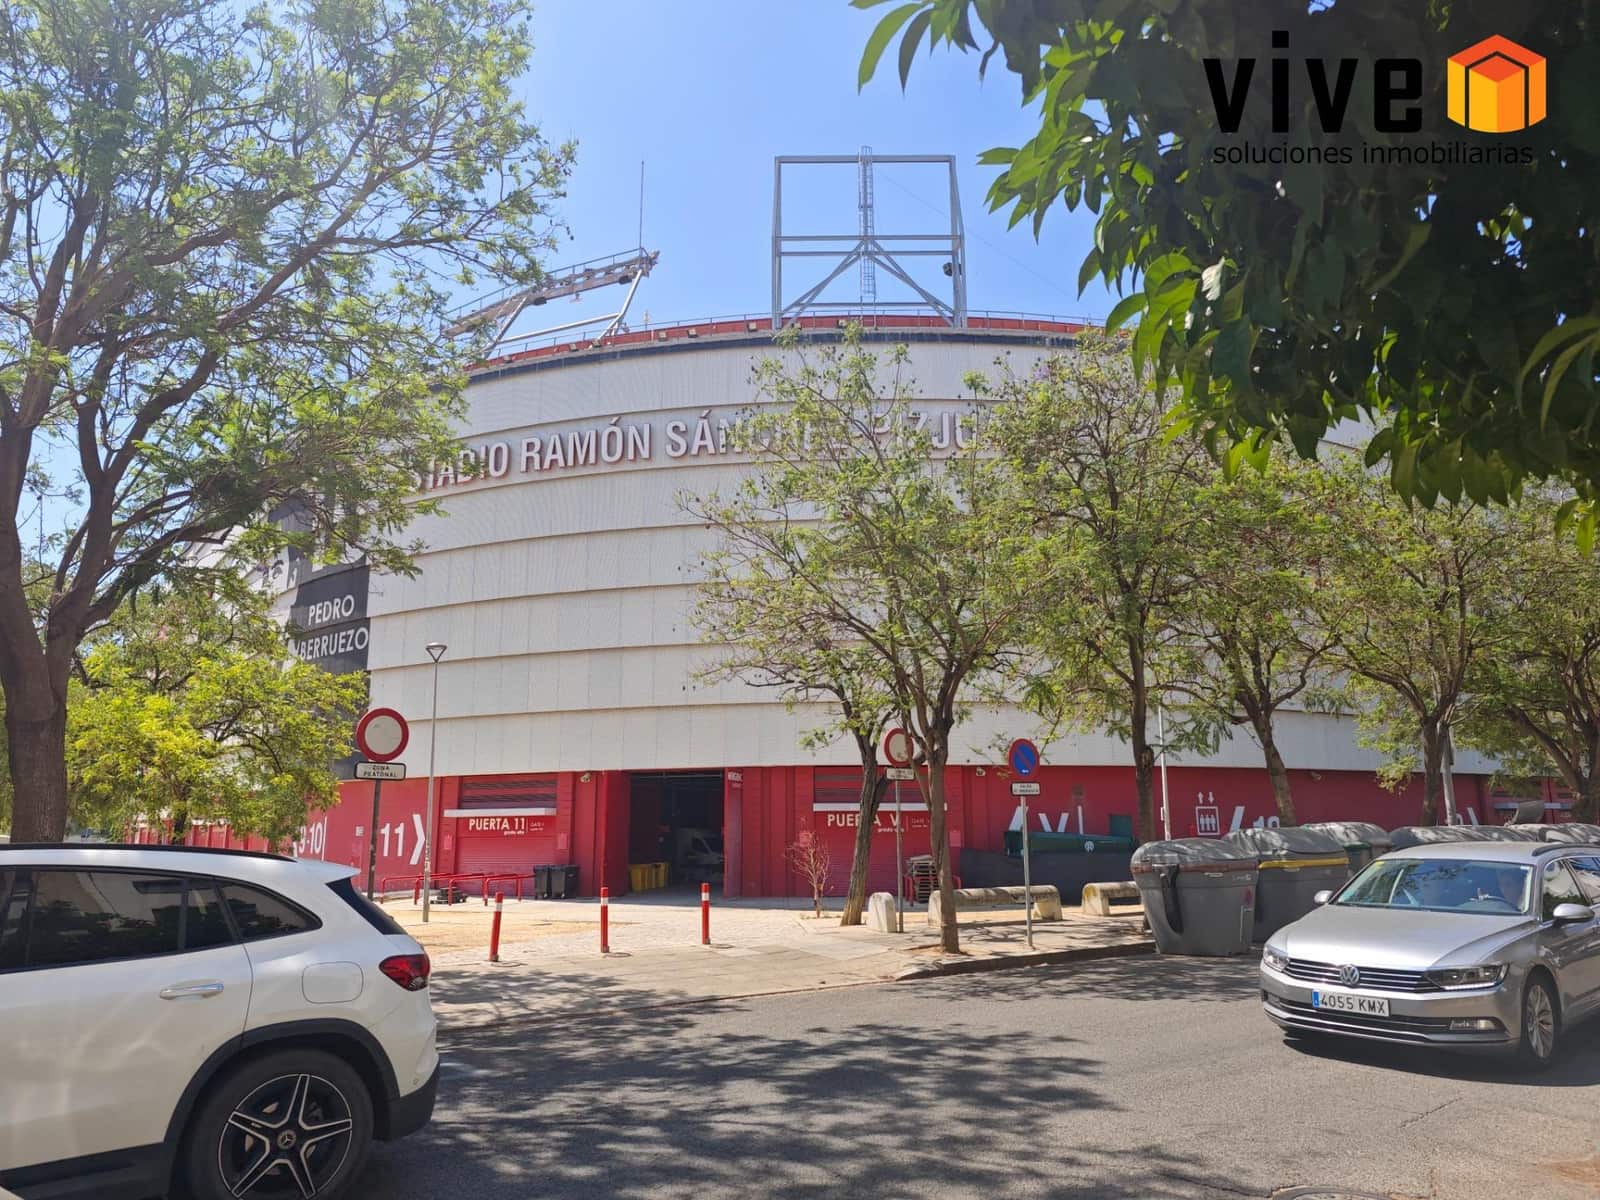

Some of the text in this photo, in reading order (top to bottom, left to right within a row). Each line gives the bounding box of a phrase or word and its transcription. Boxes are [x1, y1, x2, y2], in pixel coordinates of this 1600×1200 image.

[520, 416, 650, 473] RAMÓN
[308, 594, 355, 626] PEDRO
[300, 627, 369, 660] BERRUEZO
[468, 818, 510, 831] PUERTA
[514, 817, 525, 830] 11
[827, 813, 882, 827] PUEA
[381, 822, 404, 857] 11
[1321, 994, 1386, 1014] 4055 KMX
